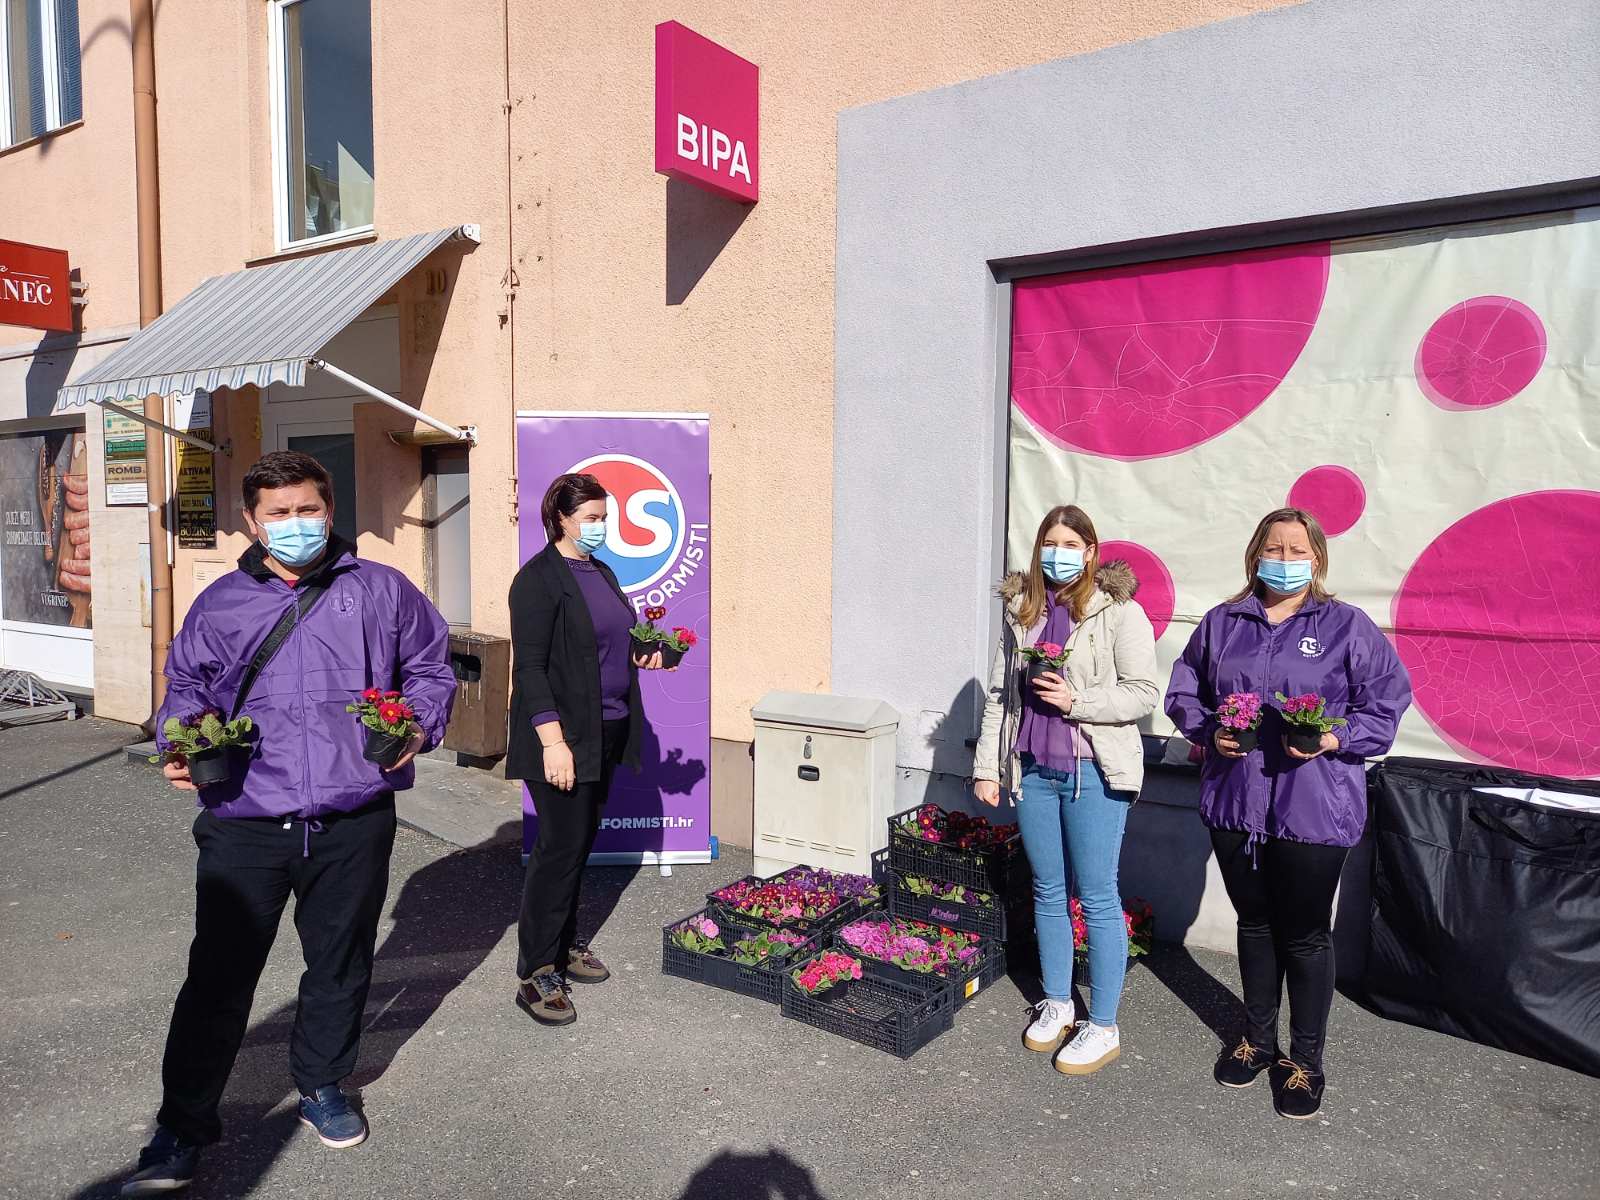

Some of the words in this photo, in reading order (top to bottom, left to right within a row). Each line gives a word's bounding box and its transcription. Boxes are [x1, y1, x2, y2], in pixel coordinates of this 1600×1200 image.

[677, 112, 752, 185] BIPA
[631, 522, 709, 615] FORMISTI
[598, 816, 694, 831] FORMISTI.hr
